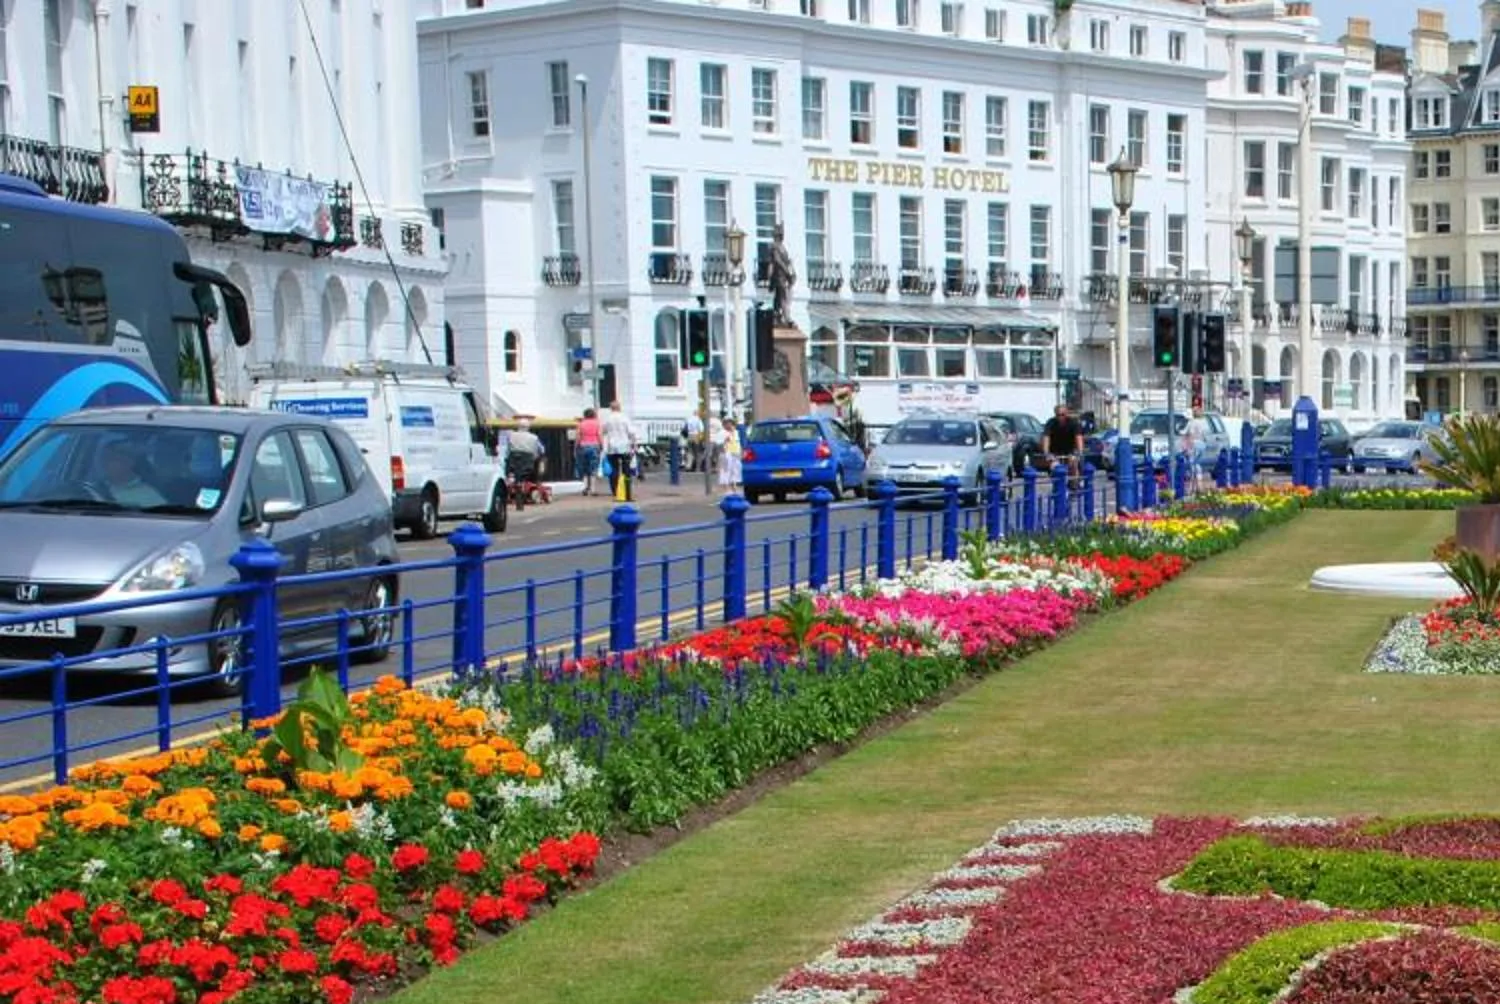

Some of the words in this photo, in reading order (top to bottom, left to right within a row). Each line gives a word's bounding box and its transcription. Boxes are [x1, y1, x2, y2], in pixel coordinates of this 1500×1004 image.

[133, 92, 152, 107] AA
[808, 157, 859, 182] THE
[866, 162, 925, 188] PIER
[932, 167, 1010, 193] HOTEL
